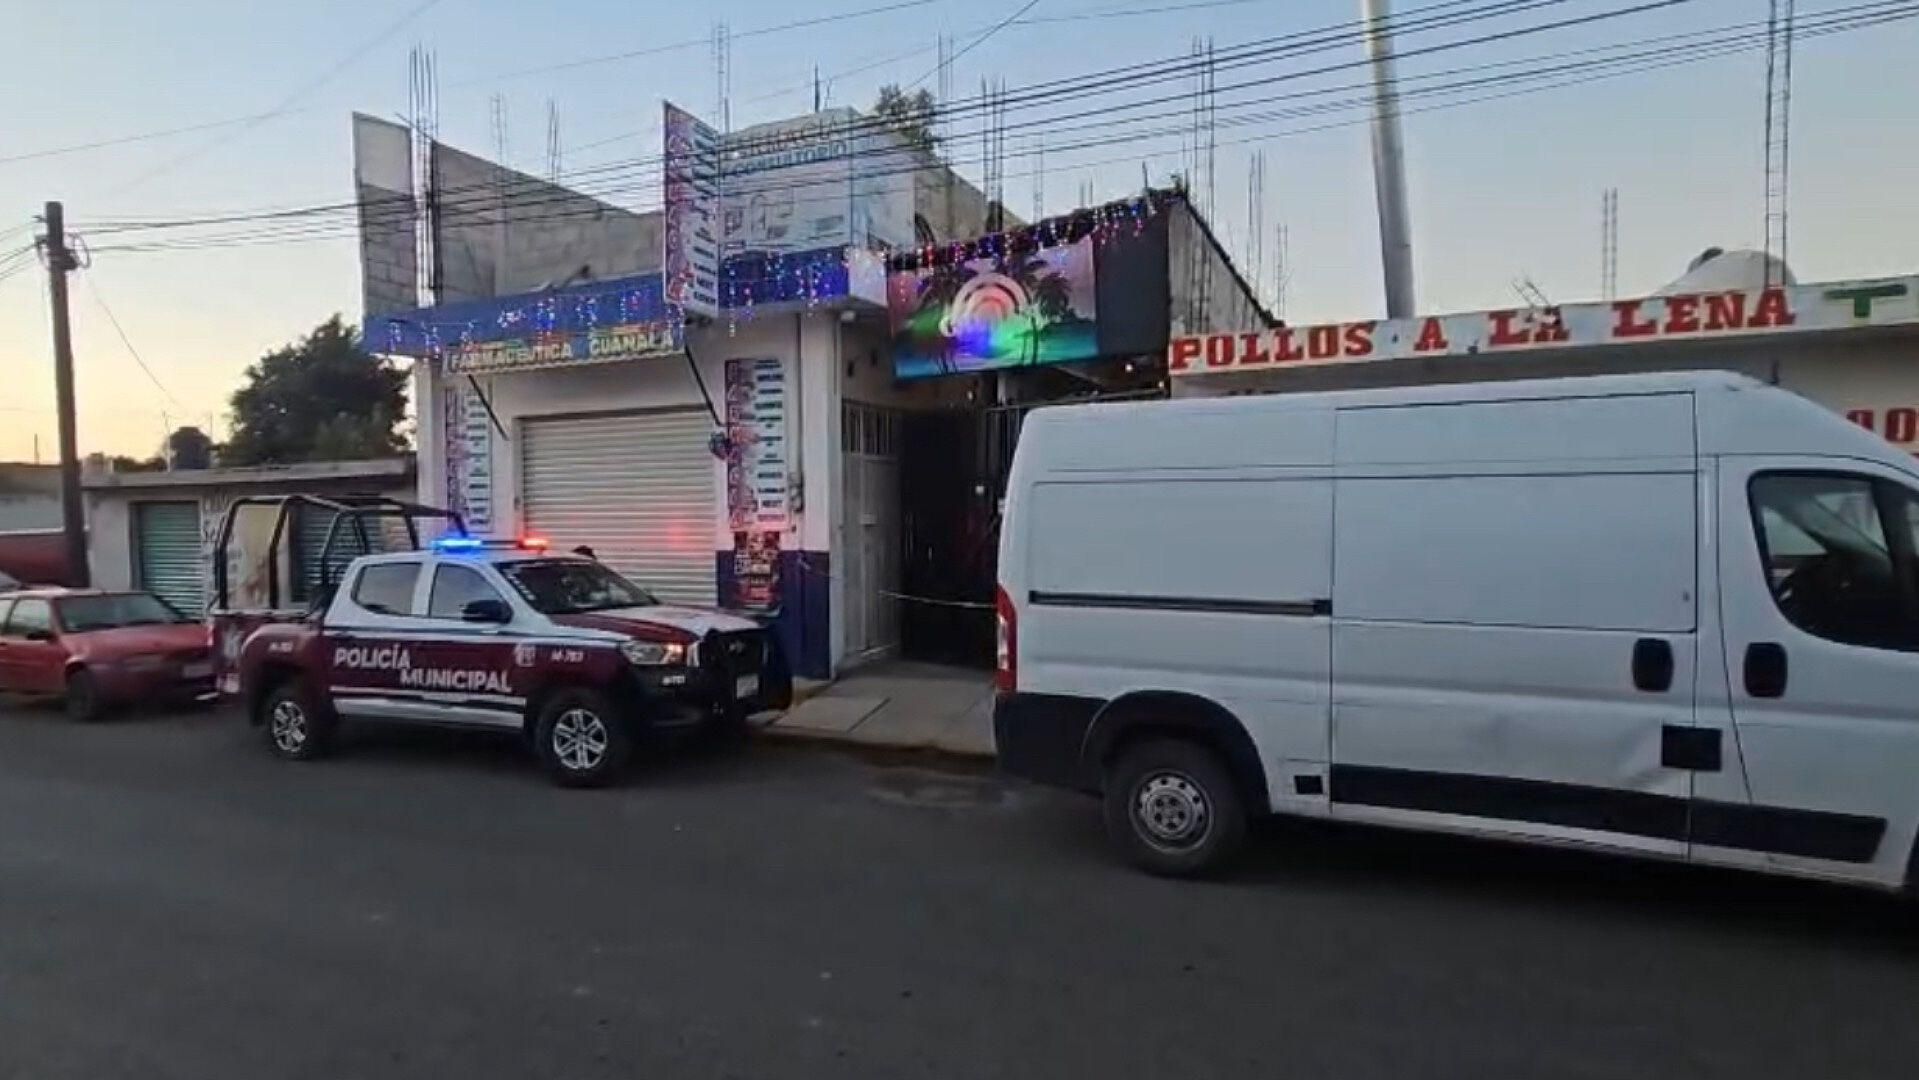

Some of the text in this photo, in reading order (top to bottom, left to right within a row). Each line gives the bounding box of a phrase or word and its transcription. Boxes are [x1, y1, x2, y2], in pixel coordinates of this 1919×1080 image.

[1170, 320, 1377, 371] POLLOS
[1413, 316, 1449, 351] A
[333, 643, 411, 670] POLICÍA
[399, 668, 512, 693] MUNICIPAL
